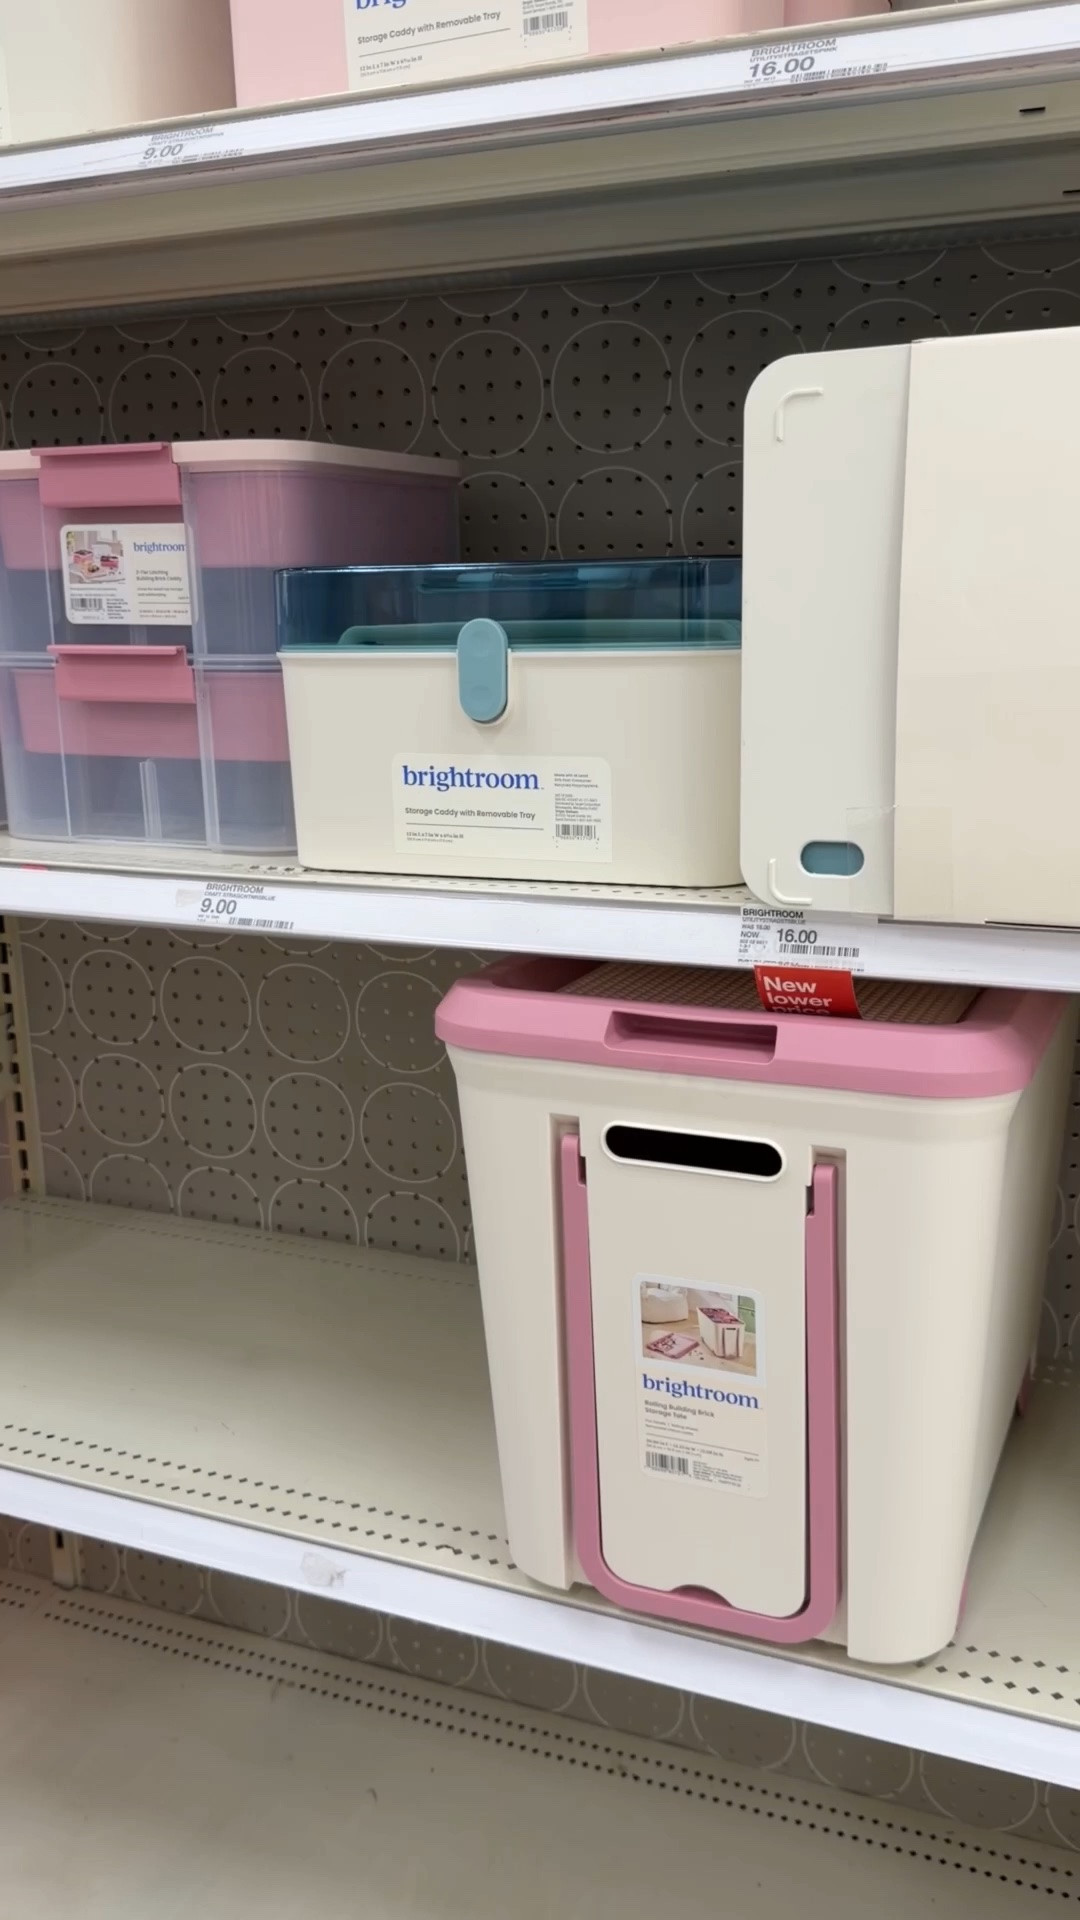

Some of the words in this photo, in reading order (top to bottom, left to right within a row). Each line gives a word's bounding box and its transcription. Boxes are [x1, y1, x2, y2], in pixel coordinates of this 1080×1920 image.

[357, 33, 388, 44] Storage
[389, 27, 416, 38] Caddy
[417, 23, 434, 33] with
[435, 14, 481, 29] Removable
[483, 11, 501, 21] Tray
[751, 38, 836, 57] BRIGHTROOM
[749, 56, 815, 77] 16.00
[143, 143, 184, 160] 9.00
[402, 765, 539, 792] brightroom
[405, 807, 433, 816] Storage
[434, 808, 458, 818] Caddy
[477, 810, 518, 819] Removable
[519, 811, 536, 821] Tray
[206, 883, 264, 894] BRIGHTROOM
[200, 898, 237, 914] 9.00
[742, 908, 804, 919] BRIGHTROOM
[777, 928, 817, 944] 16.00
[763, 976, 816, 994] New
[766, 992, 832, 1007] lower
[642, 1373, 759, 1409] brightroom
[645, 1407, 671, 1417] Storage
[669, 1404, 697, 1416] Building
[698, 1409, 715, 1418] Brick
